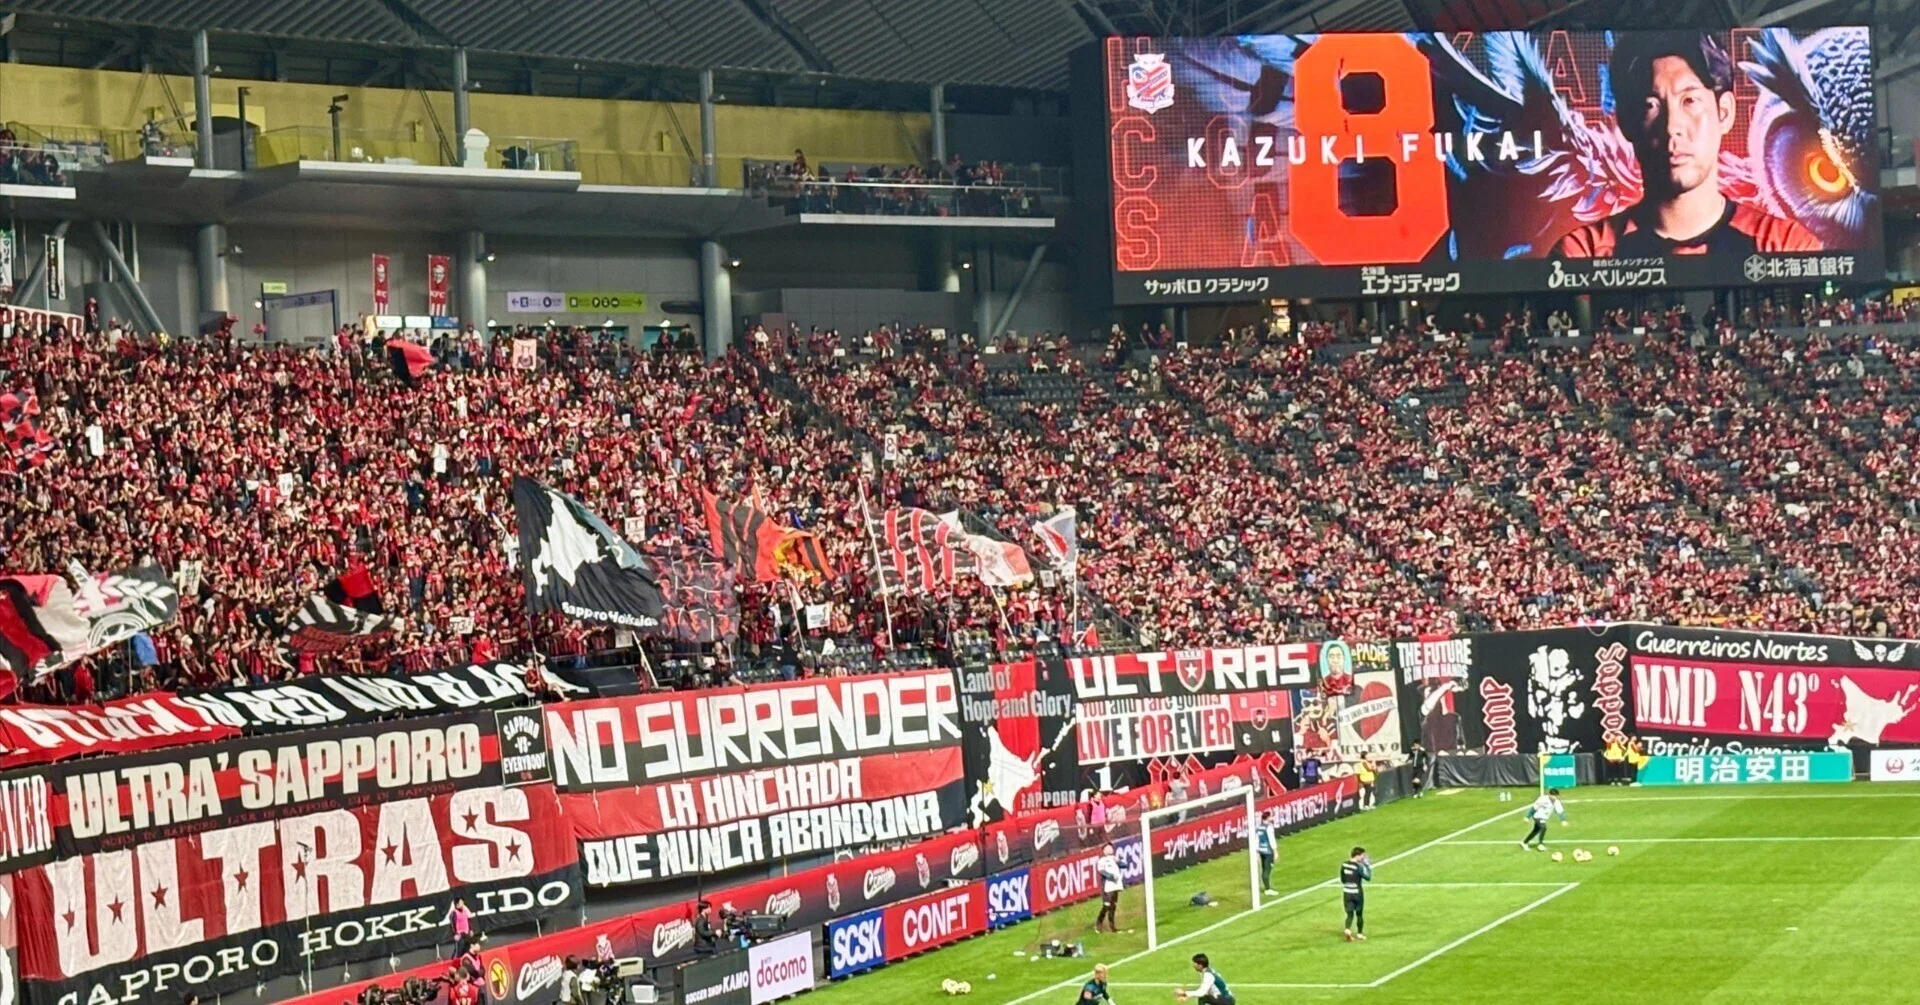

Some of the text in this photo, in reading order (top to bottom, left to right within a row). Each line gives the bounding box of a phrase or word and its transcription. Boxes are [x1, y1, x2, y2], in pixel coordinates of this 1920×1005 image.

[1187, 130, 1543, 168] KAZUKI FUKAI
[1289, 32, 1450, 266] 8
[1361, 272, 1460, 295] エナジティック
[1591, 267, 1667, 287] ベルックス
[1767, 256, 1855, 277] 北海道銀行
[1396, 638, 1472, 668] THE FUTURE
[1636, 630, 1828, 663] Guerreiros Nortes
[957, 665, 1011, 693] Land of
[1633, 663, 1717, 728] MMP
[961, 694, 999, 725] Hope
[1001, 691, 1028, 718] and
[503, 715, 540, 741] SAPPORO
[547, 672, 962, 786] NO SURRENDER
[1077, 707, 1232, 761] LIVE FOREVER
[503, 752, 546, 774] EVERYBODY
[1340, 742, 1400, 755] HUEVO
[1674, 755, 1811, 784] 明治安田
[656, 757, 862, 828] LA HINCHADA
[584, 790, 943, 888] QUE NUNCA ABANDONA
[45, 785, 535, 977] ULTRAS
[1045, 855, 1099, 903] CONFT
[988, 874, 1029, 922] SCSK
[903, 893, 970, 948] CONFT
[833, 915, 883, 972] SCSK
[722, 970, 750, 994] KAMO
[756, 955, 807, 988] docomo
